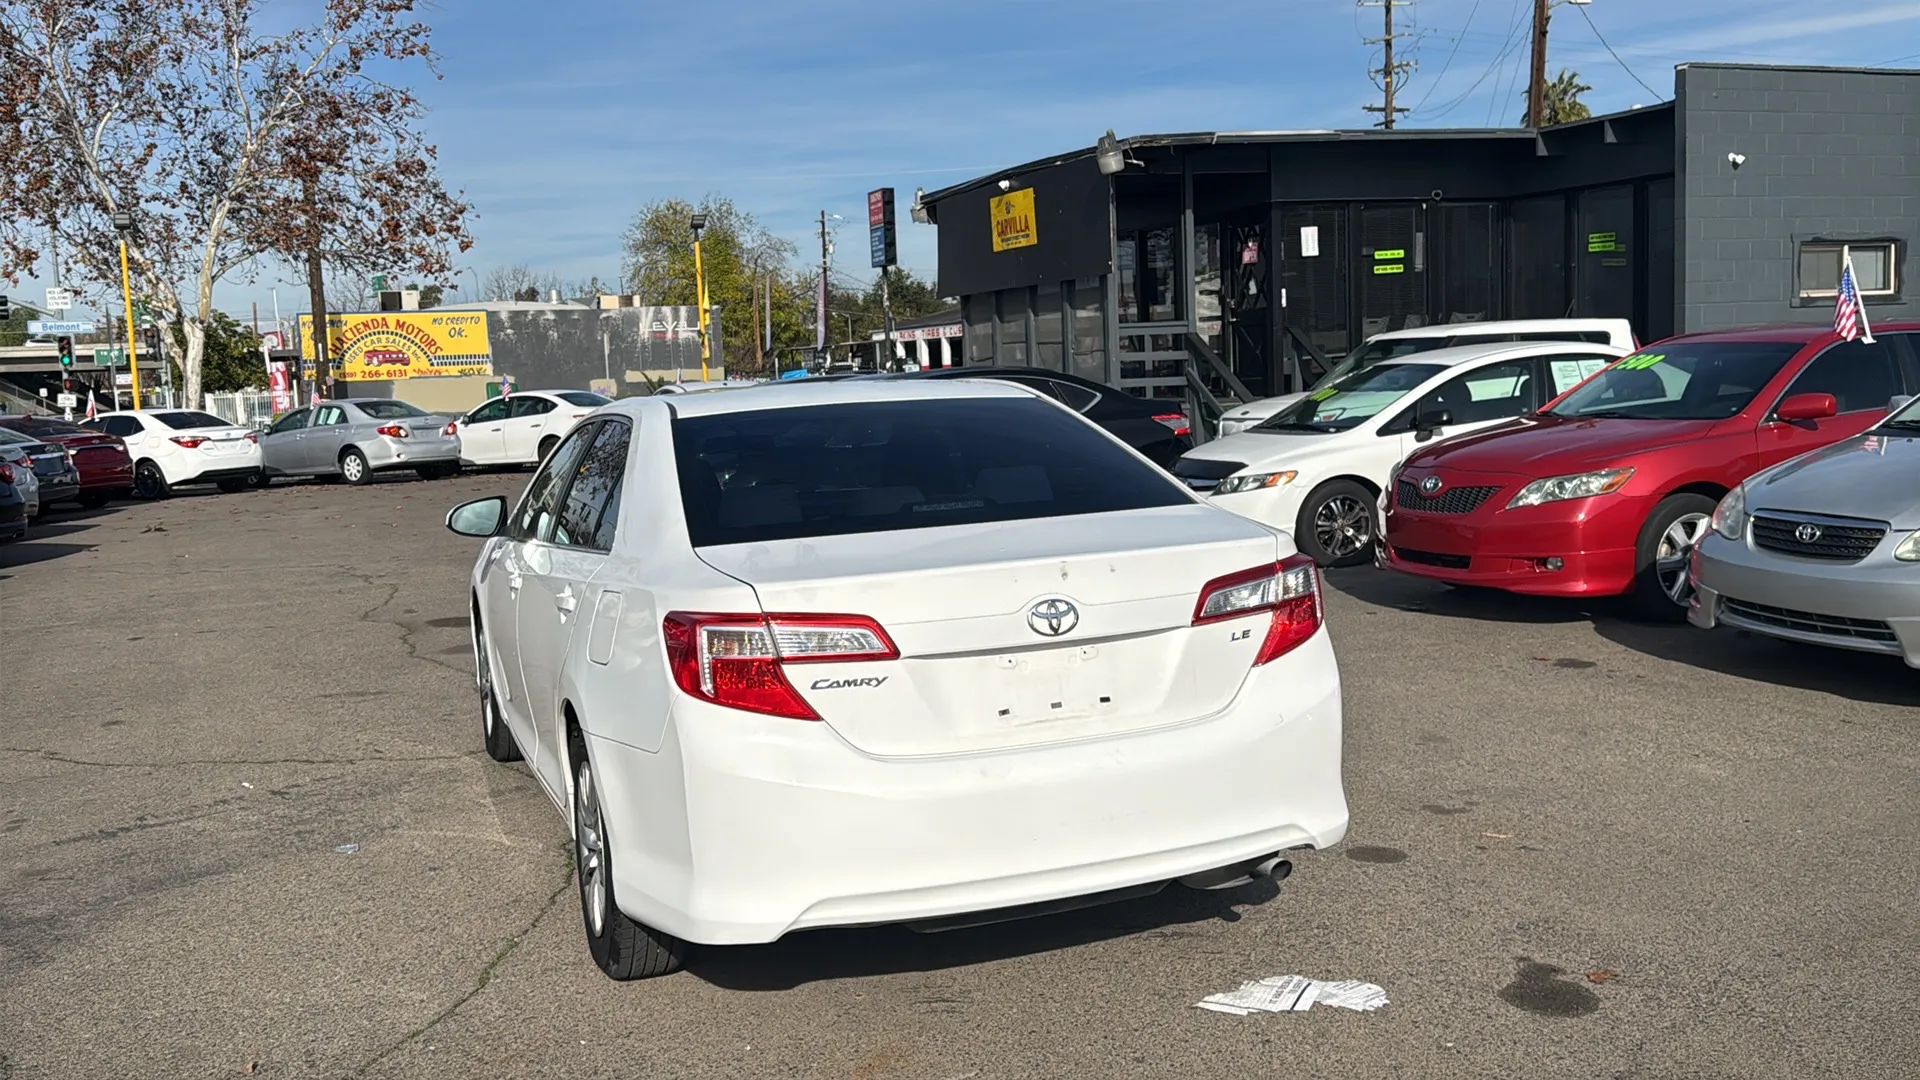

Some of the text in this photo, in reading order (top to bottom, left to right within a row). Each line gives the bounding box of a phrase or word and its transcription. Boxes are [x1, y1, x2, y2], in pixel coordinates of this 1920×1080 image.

[996, 213, 1030, 238] CARVILLA
[41, 322, 81, 332] Belmont
[445, 315, 481, 326] CREDITO
[329, 317, 444, 356] HACIENDA MOTORS
[346, 346, 364, 364] USED
[363, 336, 383, 349] CAR
[385, 336, 413, 352] SALES
[1231, 629, 1252, 642] LE
[810, 675, 889, 691] CAMRY
